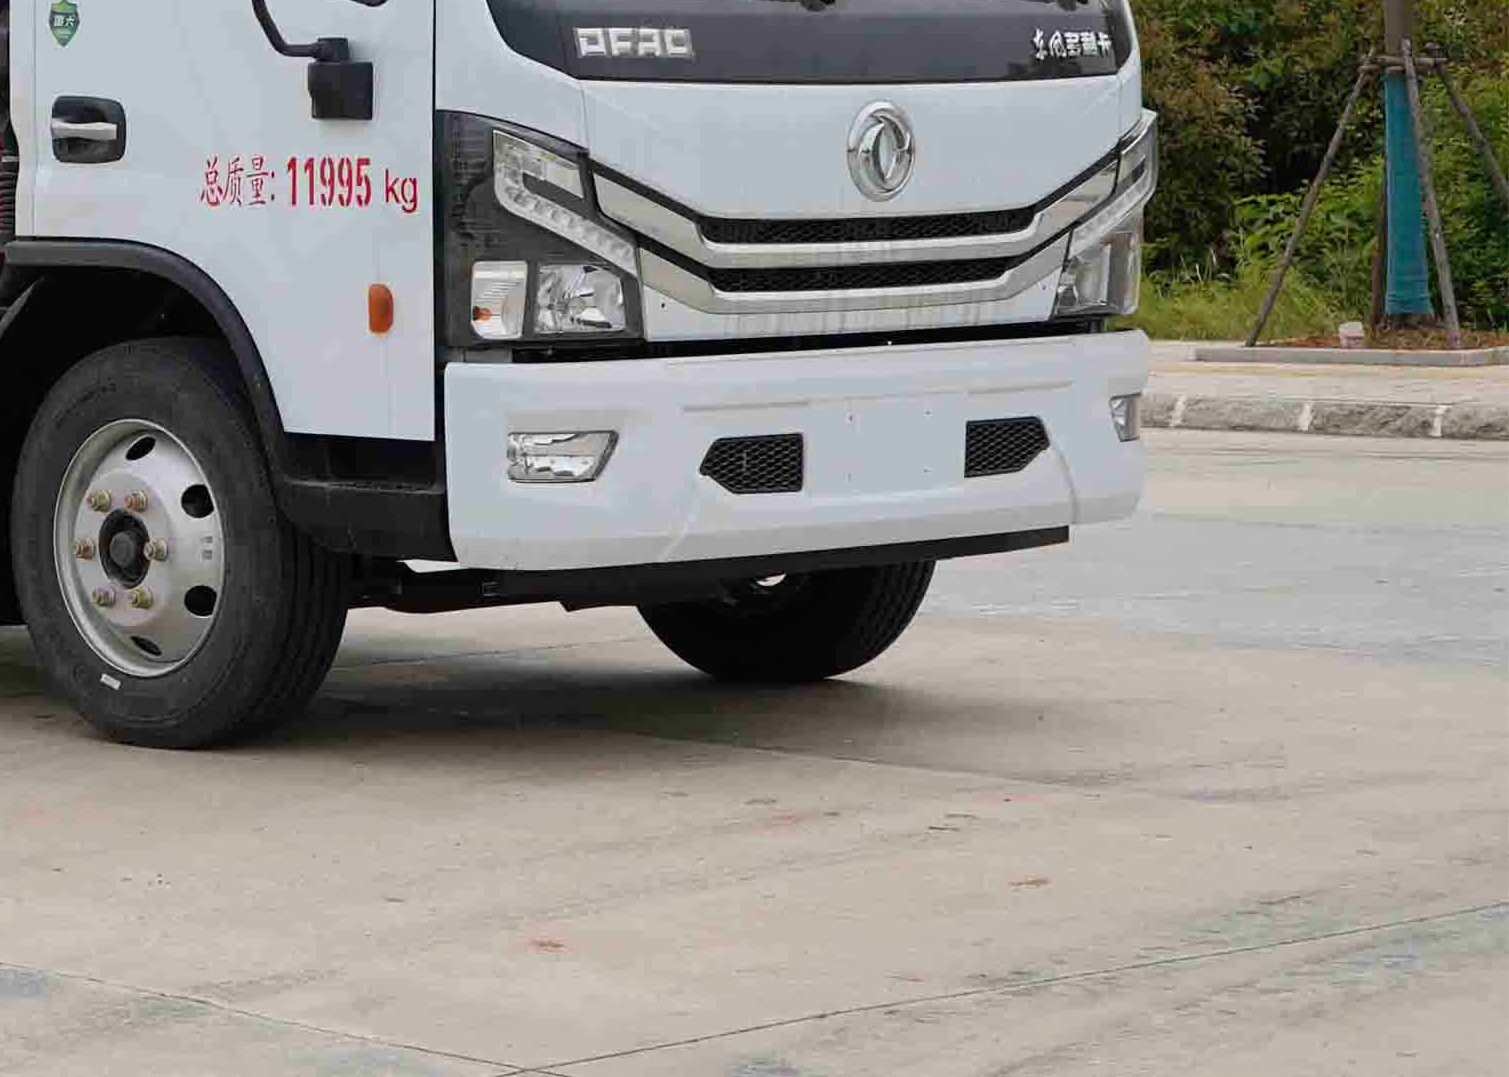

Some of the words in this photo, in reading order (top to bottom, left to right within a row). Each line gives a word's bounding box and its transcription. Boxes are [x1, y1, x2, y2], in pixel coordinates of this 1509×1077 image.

[574, 27, 693, 57] DFAC
[199, 155, 276, 207] 总质量:
[287, 156, 372, 208] 11995
[384, 168, 418, 214] kg
